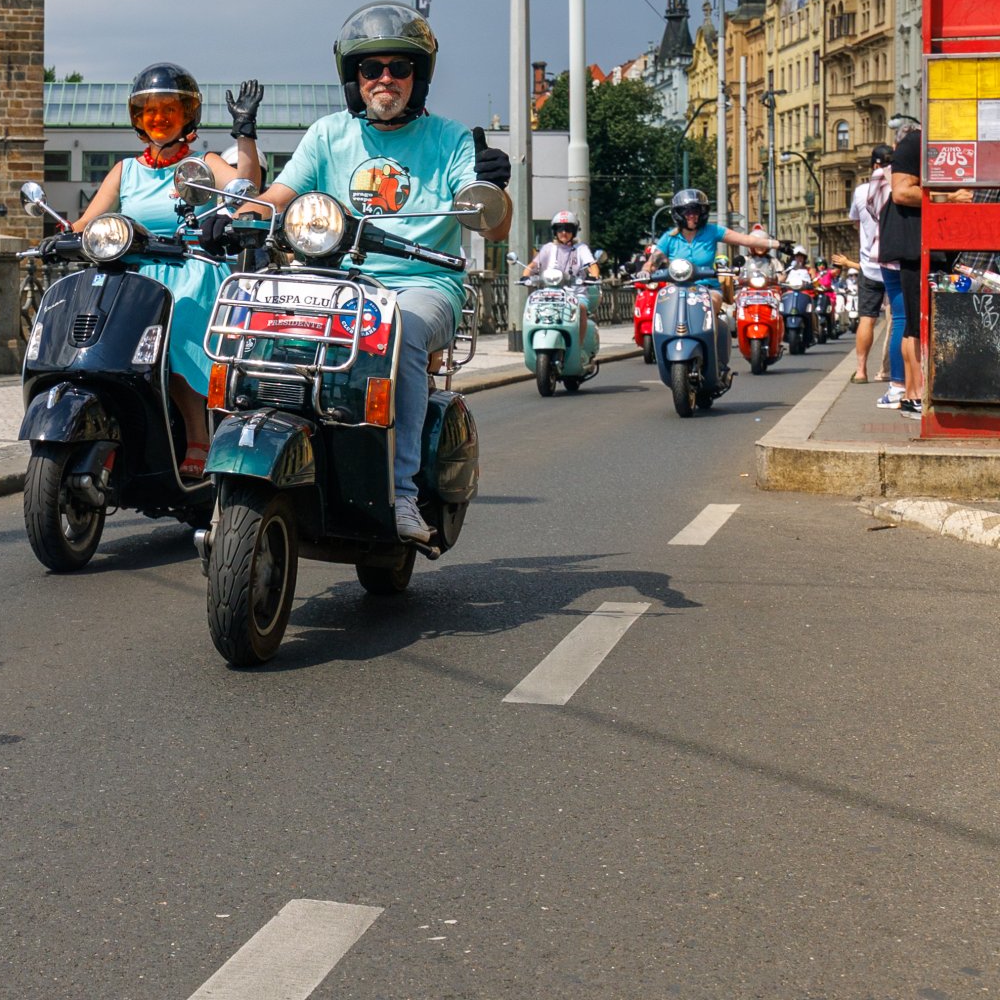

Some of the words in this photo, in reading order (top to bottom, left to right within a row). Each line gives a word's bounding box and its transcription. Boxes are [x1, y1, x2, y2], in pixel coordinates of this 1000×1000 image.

[933, 151, 968, 166] BUS
[362, 203, 373, 213] 14
[265, 295, 300, 304] VESPA
[303, 296, 338, 308] CLU
[267, 319, 322, 329] PRESIDENTE
